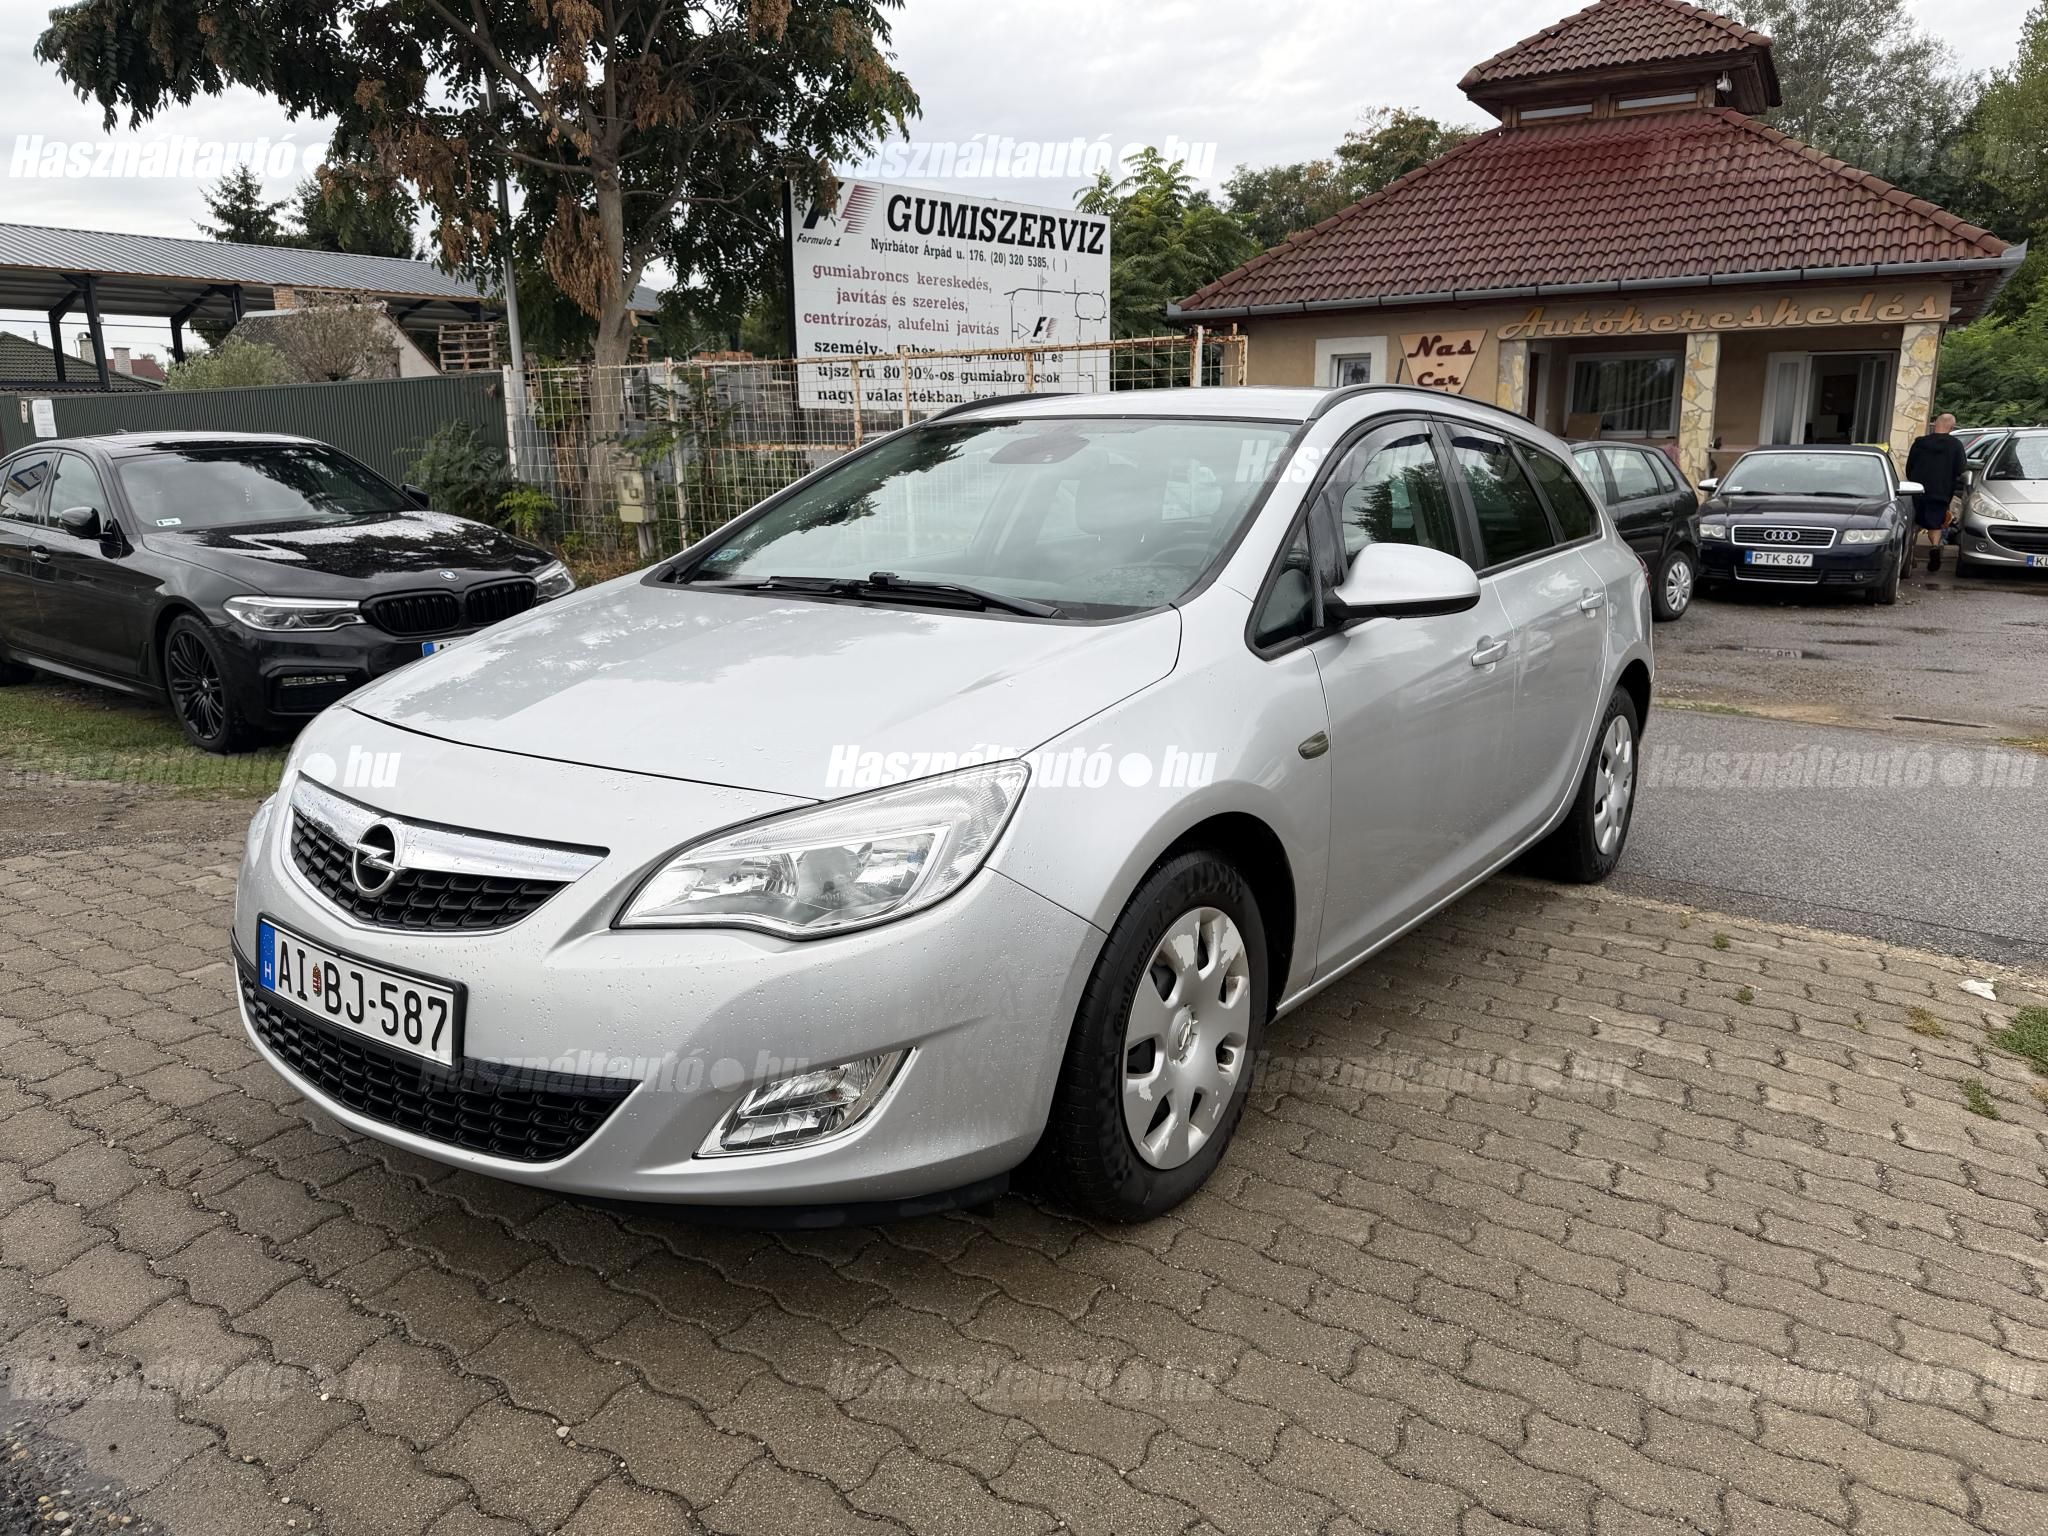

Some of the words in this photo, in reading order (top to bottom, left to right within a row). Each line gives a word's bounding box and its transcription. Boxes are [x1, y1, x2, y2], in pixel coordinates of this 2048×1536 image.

[887, 194, 1106, 255] GUMISZERVIZ
[797, 233, 832, 246] Formula
[834, 238, 841, 246] 1
[871, 238, 919, 255] Nyírbátor
[923, 240, 952, 260] Árpád
[956, 252, 965, 260] u.
[969, 250, 986, 262] 176.
[990, 251, 1006, 267] (20)
[1009, 254, 1024, 266] 320
[1028, 256, 1049, 270] 5385,
[812, 264, 909, 284] gumiabroncs
[917, 272, 992, 293] kereskedés,
[836, 288, 887, 305] javítás
[892, 291, 906, 306] és
[913, 295, 969, 314] szerelés,
[803, 312, 891, 331] centrírozás,
[898, 317, 949, 333] alufelni
[957, 321, 1000, 336] javítás
[1497, 292, 1944, 341] Autókereskedés
[1407, 335, 1476, 358] Nas
[818, 363, 876, 380] újszrű
[960, 370, 1060, 384] gumiabrocsok
[1417, 371, 1461, 386] Car
[817, 389, 855, 404] nagy
[1754, 553, 1810, 565] PTK-847
[264, 960, 272, 981] H
[324, 961, 448, 1052] BJ-587
